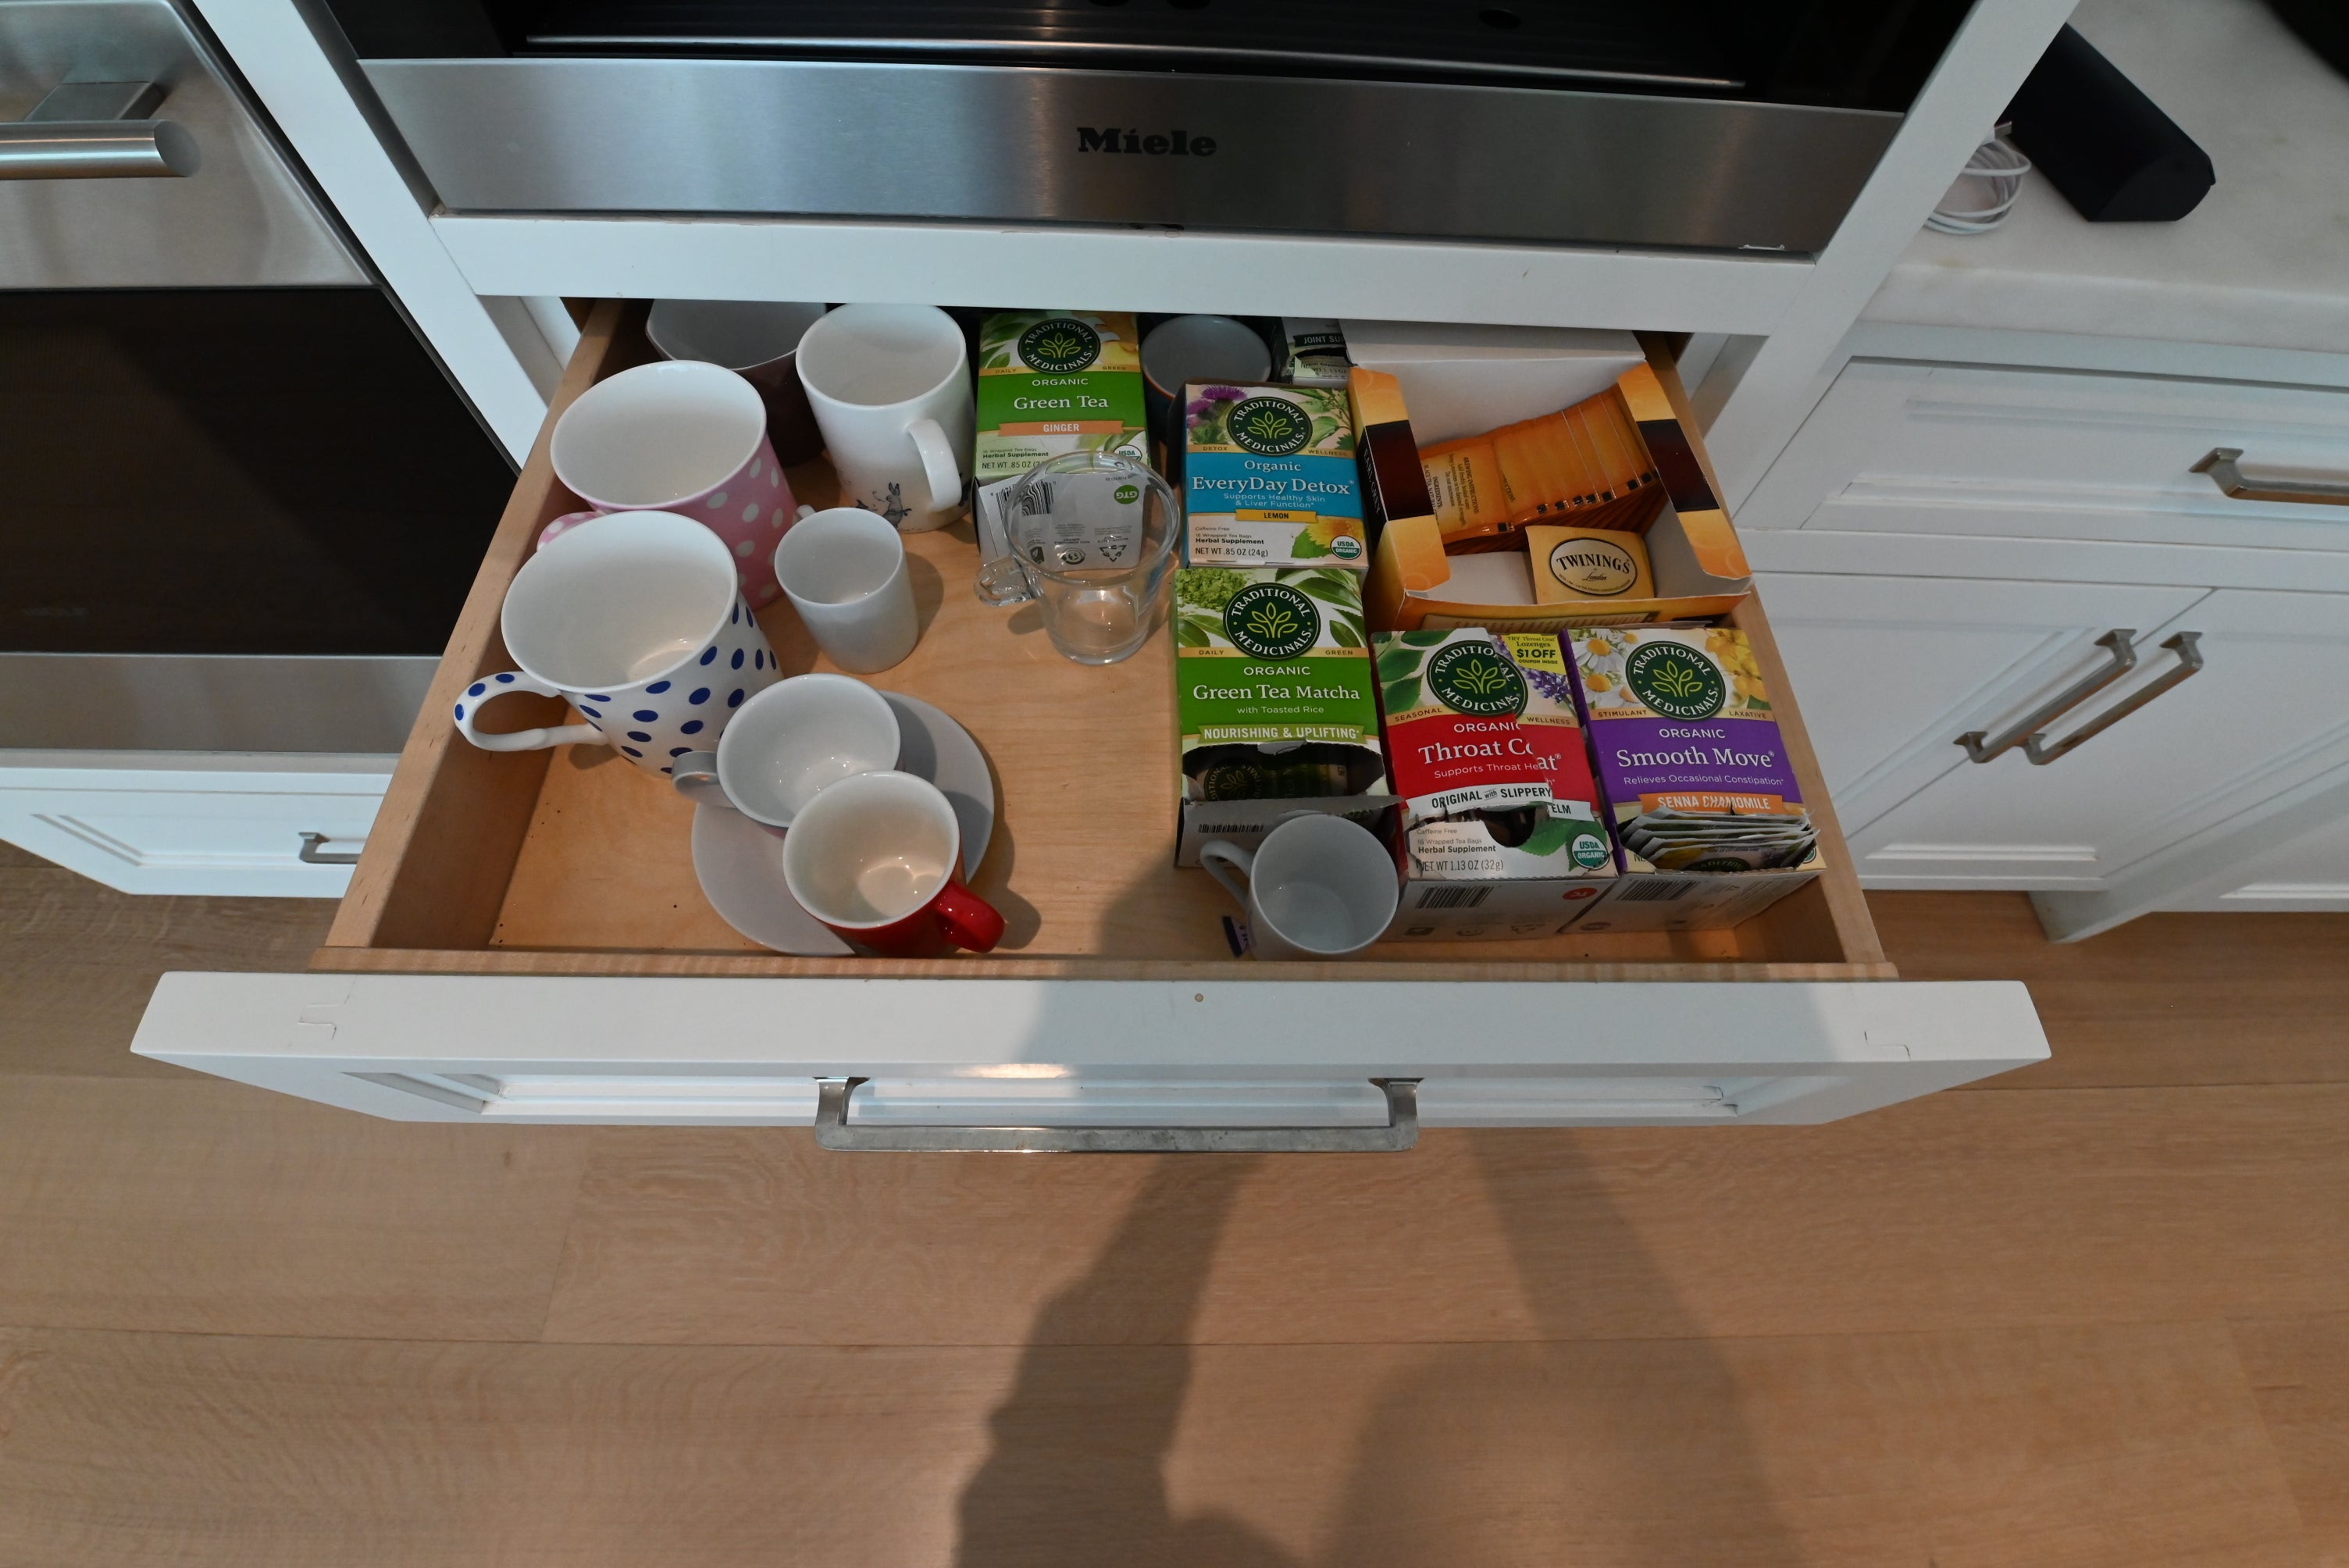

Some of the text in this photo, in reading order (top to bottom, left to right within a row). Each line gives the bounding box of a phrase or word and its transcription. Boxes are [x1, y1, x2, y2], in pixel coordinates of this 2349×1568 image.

[1077, 127, 1217, 157] Miele
[1025, 322, 1093, 344] TRADITIONAL
[1304, 336, 1326, 344] JOINT
[1026, 351, 1093, 372] MEDICINALS
[1032, 378, 1089, 387] ORGANIC
[1014, 395, 1109, 410] Green Tea
[1233, 401, 1306, 423] TRADITIONAL
[1043, 423, 1080, 433] GINGER
[1236, 432, 1304, 453] MEDICINALS
[1244, 460, 1302, 472] Organic
[1463, 457, 1473, 479] BREWING
[1192, 476, 1351, 495] EveryDay Detox
[1115, 490, 1139, 499] GTG
[1263, 511, 1289, 520] LEMON
[1248, 548, 1269, 558] (24g)
[1556, 553, 1631, 575] TWININGS
[1581, 571, 1608, 582] London
[1232, 587, 1311, 618] TRADITIONAL
[1235, 629, 1312, 657] MEDICINALS
[1517, 648, 1556, 658] $1 OFF
[1632, 646, 1712, 675] TRADITIONAL
[1243, 665, 1311, 676] ORGANIC
[1192, 684, 1360, 700] Green Tea Matcha
[1641, 687, 1719, 716] MEDICINALS
[1237, 705, 1324, 715] with Toasted Rice
[1395, 707, 1570, 725] SEASONAL WELLNESS
[1597, 709, 1768, 719] STIMULANT LAXATIVE
[1203, 728, 1279, 739] NOURISHING
[1282, 727, 1292, 738] &
[1658, 728, 1727, 739] ORGANIC
[1417, 741, 1503, 764] Throat
[1616, 746, 1710, 768] Smooth
[1435, 764, 1484, 779] Supports
[1486, 763, 1522, 772] Throat
[1624, 775, 1666, 786] Relieves
[1669, 774, 1723, 783] Occasional
[1431, 787, 1572, 814] ORIGINAL with SLIPPERY ELM
[1657, 795, 1772, 811] SENNA CHAMOMILE
[1447, 845, 1497, 854] Supplement
[1578, 840, 1600, 850] USDA
[1577, 850, 1606, 860] ORGANIC
[1416, 859, 1504, 871] NET WT 1.13 OZ (32g)
